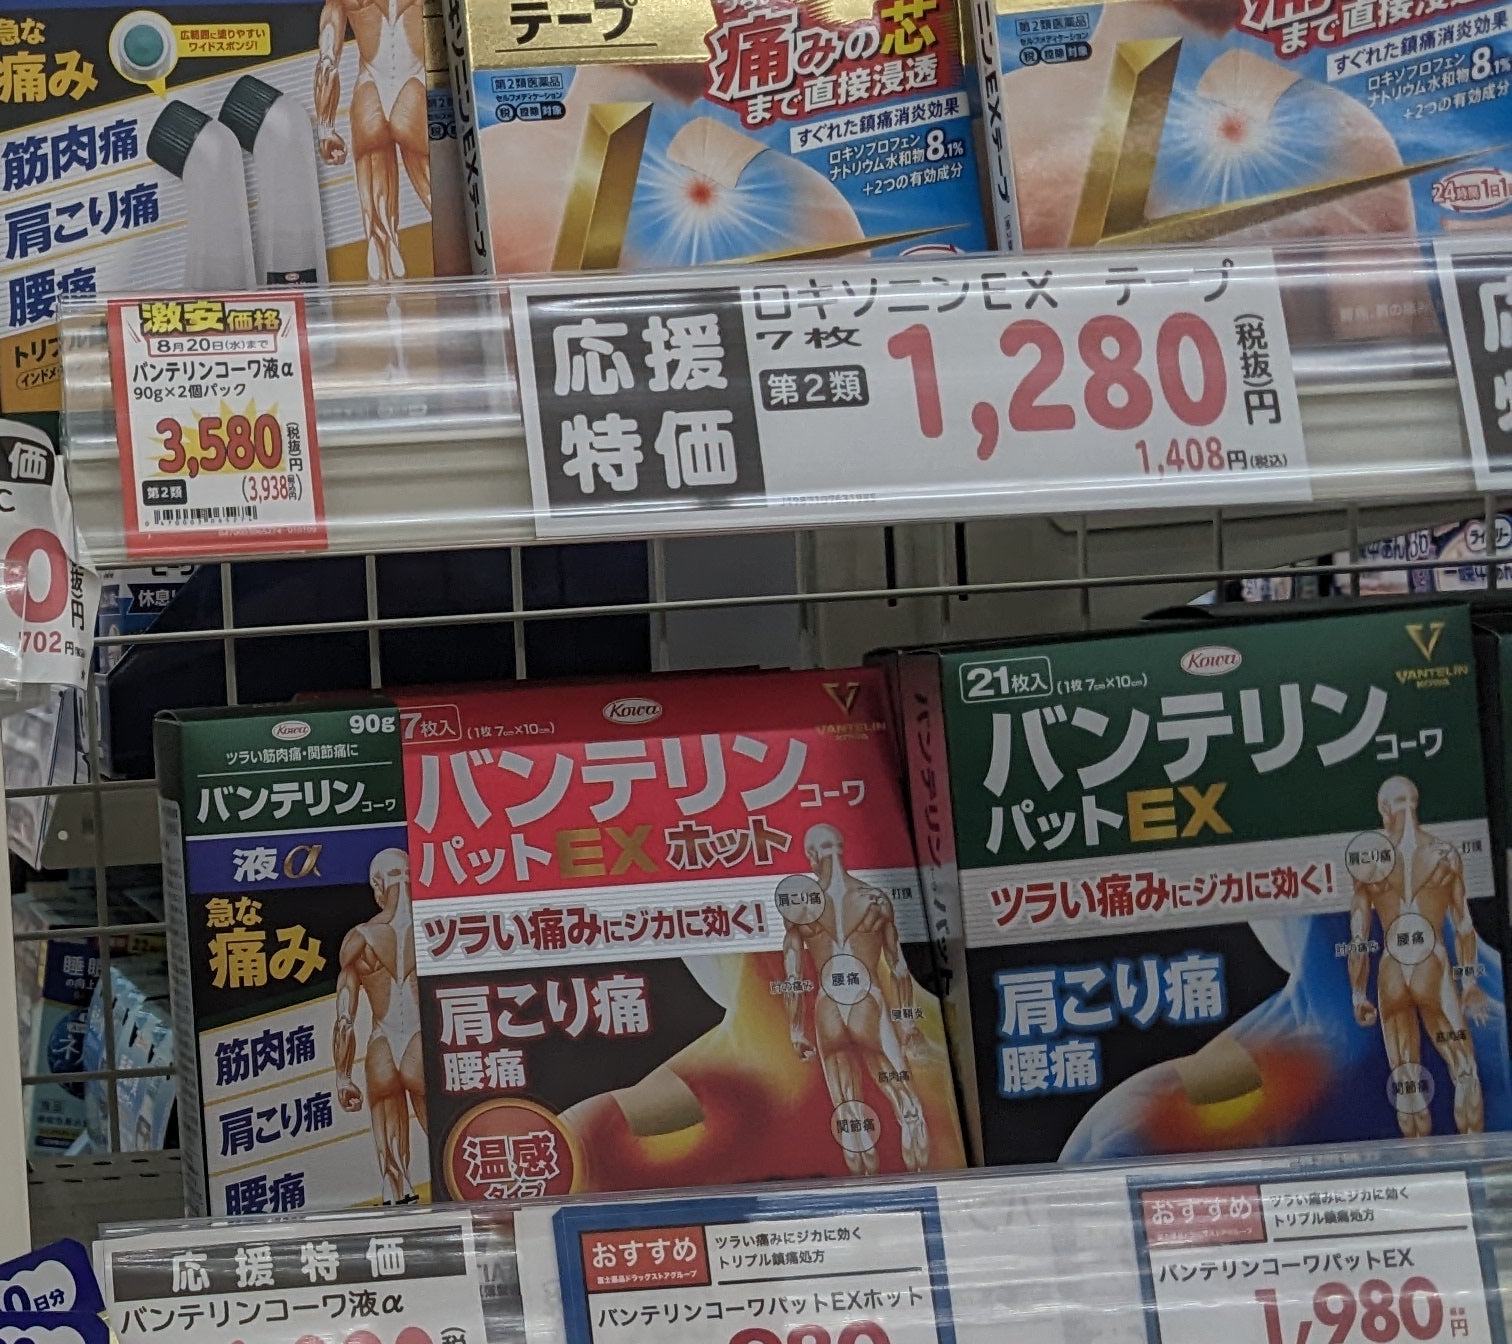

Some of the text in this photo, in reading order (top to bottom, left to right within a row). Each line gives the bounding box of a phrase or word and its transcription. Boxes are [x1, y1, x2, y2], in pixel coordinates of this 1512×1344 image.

[746, 55, 939, 125] まで直接浸透
[797, 97, 960, 147] すぐれた鎮痛消炎効果
[1, 120, 139, 192] 筋肉痛
[139, 301, 280, 334] 激安価格
[756, 326, 862, 350] 7枚
[156, 338, 269, 353] 8月20日(水)まで
[553, 313, 729, 397] 応援
[132, 359, 293, 383] バンテリンコーワ液α
[767, 370, 864, 407] 第2類
[886, 311, 1228, 462] 1,280
[133, 384, 246, 403] 90g×2個パック
[156, 414, 283, 477] 3,580
[561, 410, 738, 495] 特価
[965, 664, 1050, 699] 21枚入
[349, 714, 397, 735] 90g
[404, 710, 456, 739] 7枚入
[205, 897, 263, 927] 急な
[424, 903, 767, 956] ツラい痛みにジカに効く!
[208, 924, 327, 990] 痛み
[437, 973, 650, 1045] 肩こり痛
[998, 955, 1223, 1037] 肩こり痛
[214, 1025, 315, 1087] 筋肉痛
[443, 1048, 526, 1091] 腰痛
[1002, 1038, 1099, 1094] 腰痛
[461, 1130, 560, 1186] 温感
[1150, 1198, 1253, 1226] おすすめ
[592, 1240, 698, 1269] おすすめ
[715, 1227, 863, 1250] ツラい痛みにジカに効く
[717, 1249, 826, 1270] トリプル鎮痛処方
[171, 1236, 406, 1293] 応援特価
[1158, 1248, 1415, 1283] バンテリンコーワパットEX
[598, 1286, 923, 1329] バンテリンコーワパットEXホット
